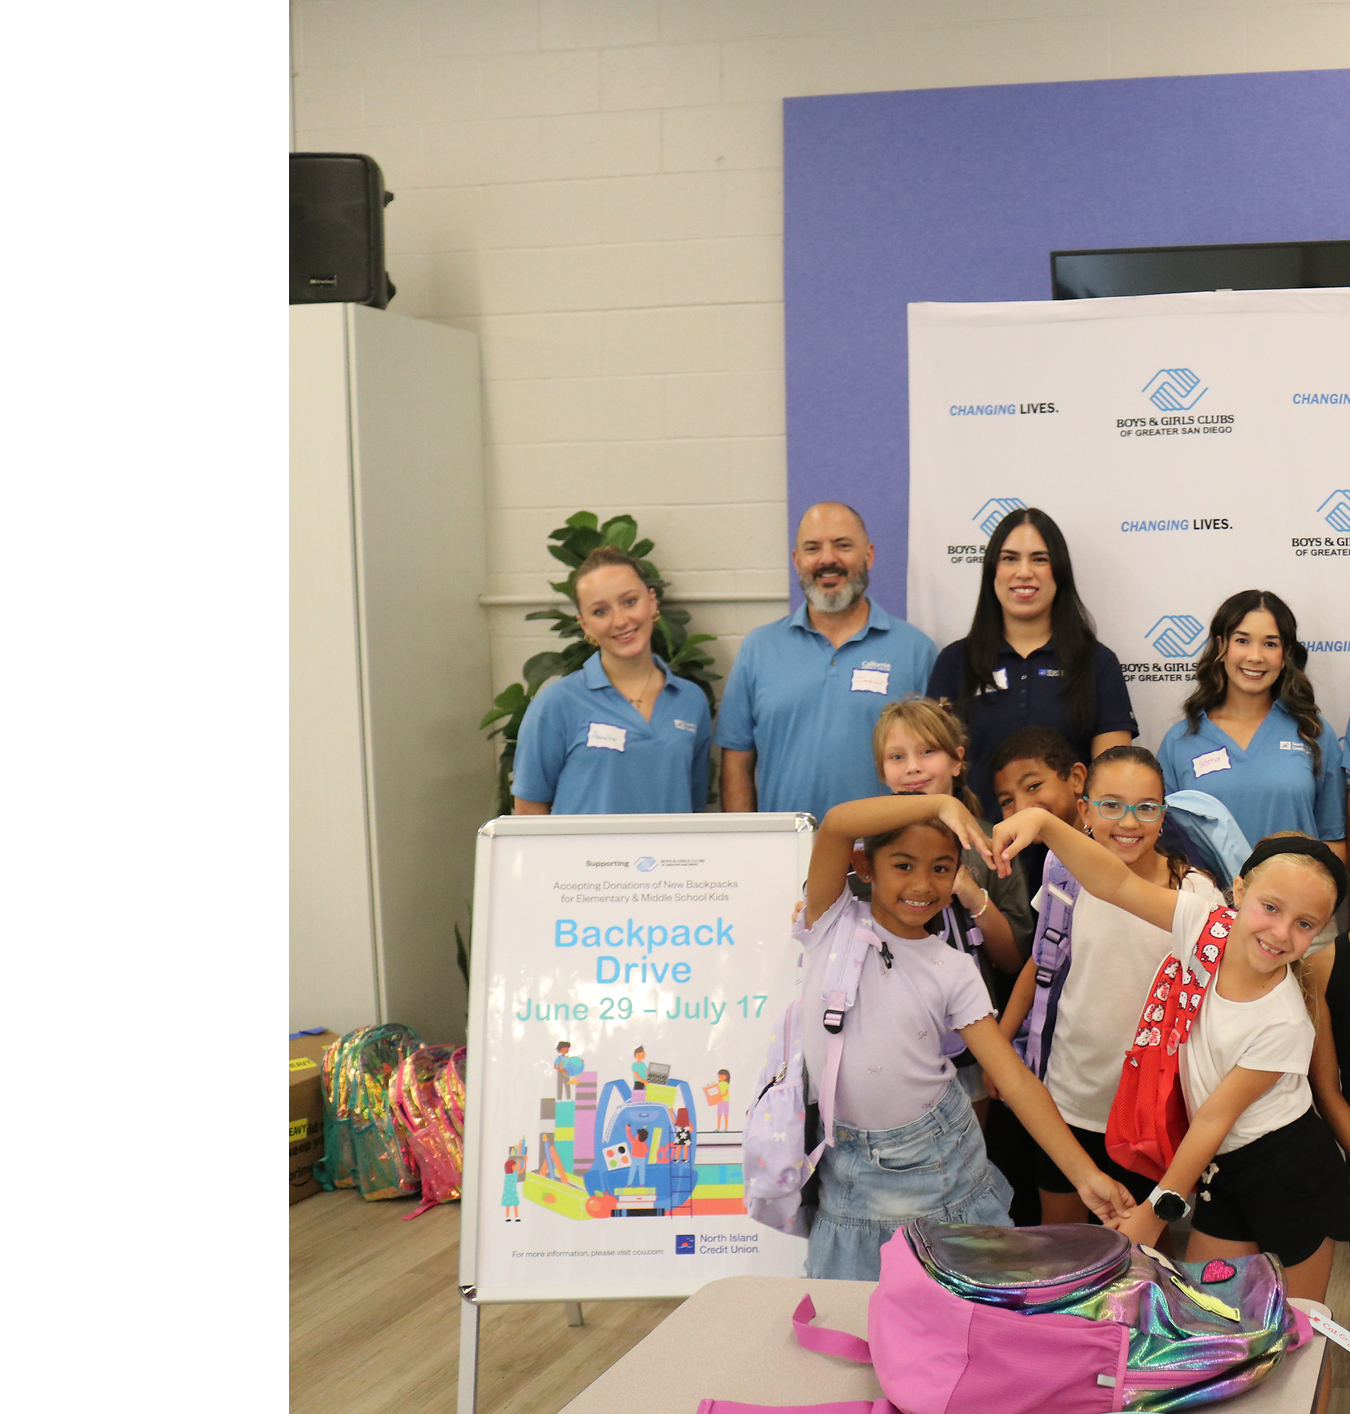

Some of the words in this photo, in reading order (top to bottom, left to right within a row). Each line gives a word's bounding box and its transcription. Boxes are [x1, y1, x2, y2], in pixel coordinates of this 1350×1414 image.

[950, 404, 1016, 416] CHANGING
[1020, 402, 1058, 414] LIVES.
[1116, 418, 1146, 428] BOYS
[1148, 416, 1158, 426] &
[1160, 416, 1194, 426] GIRLS
[1198, 414, 1234, 424] CLUBS
[1120, 430, 1132, 438] OF
[1134, 428, 1178, 436] GREATER
[1202, 426, 1232, 434] DIEGO
[1120, 520, 1188, 532] CHANGING
[1194, 518, 1232, 530] LIVES.
[1292, 538, 1322, 546] BOYS
[1324, 538, 1334, 546] &
[948, 544, 976, 554] BOYS
[1296, 548, 1308, 556] OF
[1120, 663, 1150, 672] BOYS
[1152, 663, 1162, 672] &
[1164, 662, 1198, 672] GIRLS
[586, 860, 630, 868] Supporting
[552, 882, 602, 892] Accepting
[602, 880, 650, 890] Donations
[652, 880, 662, 890] of
[664, 880, 684, 888] New
[686, 880, 738, 890] Backpacks
[560, 894, 574, 904] for
[576, 894, 630, 904] Elementary
[632, 894, 638, 902] &
[640, 894, 672, 902] Middle
[674, 892, 708, 902] School
[708, 892, 730, 902] Kids
[554, 916, 734, 954] Backpack
[596, 955, 692, 984] Drive
[516, 998, 588, 1022] June
[600, 996, 632, 1020] 29
[666, 996, 726, 1026] July
[736, 996, 768, 1018] 17
[289, 1124, 307, 1137] EAVY
[700, 1234, 726, 1242] North
[730, 1234, 758, 1242] Island
[512, 1250, 524, 1258] For
[546, 1250, 590, 1258] information,
[590, 1250, 616, 1258] please
[700, 1246, 728, 1254] Credit
[1322, 1322, 1338, 1336] Cat
